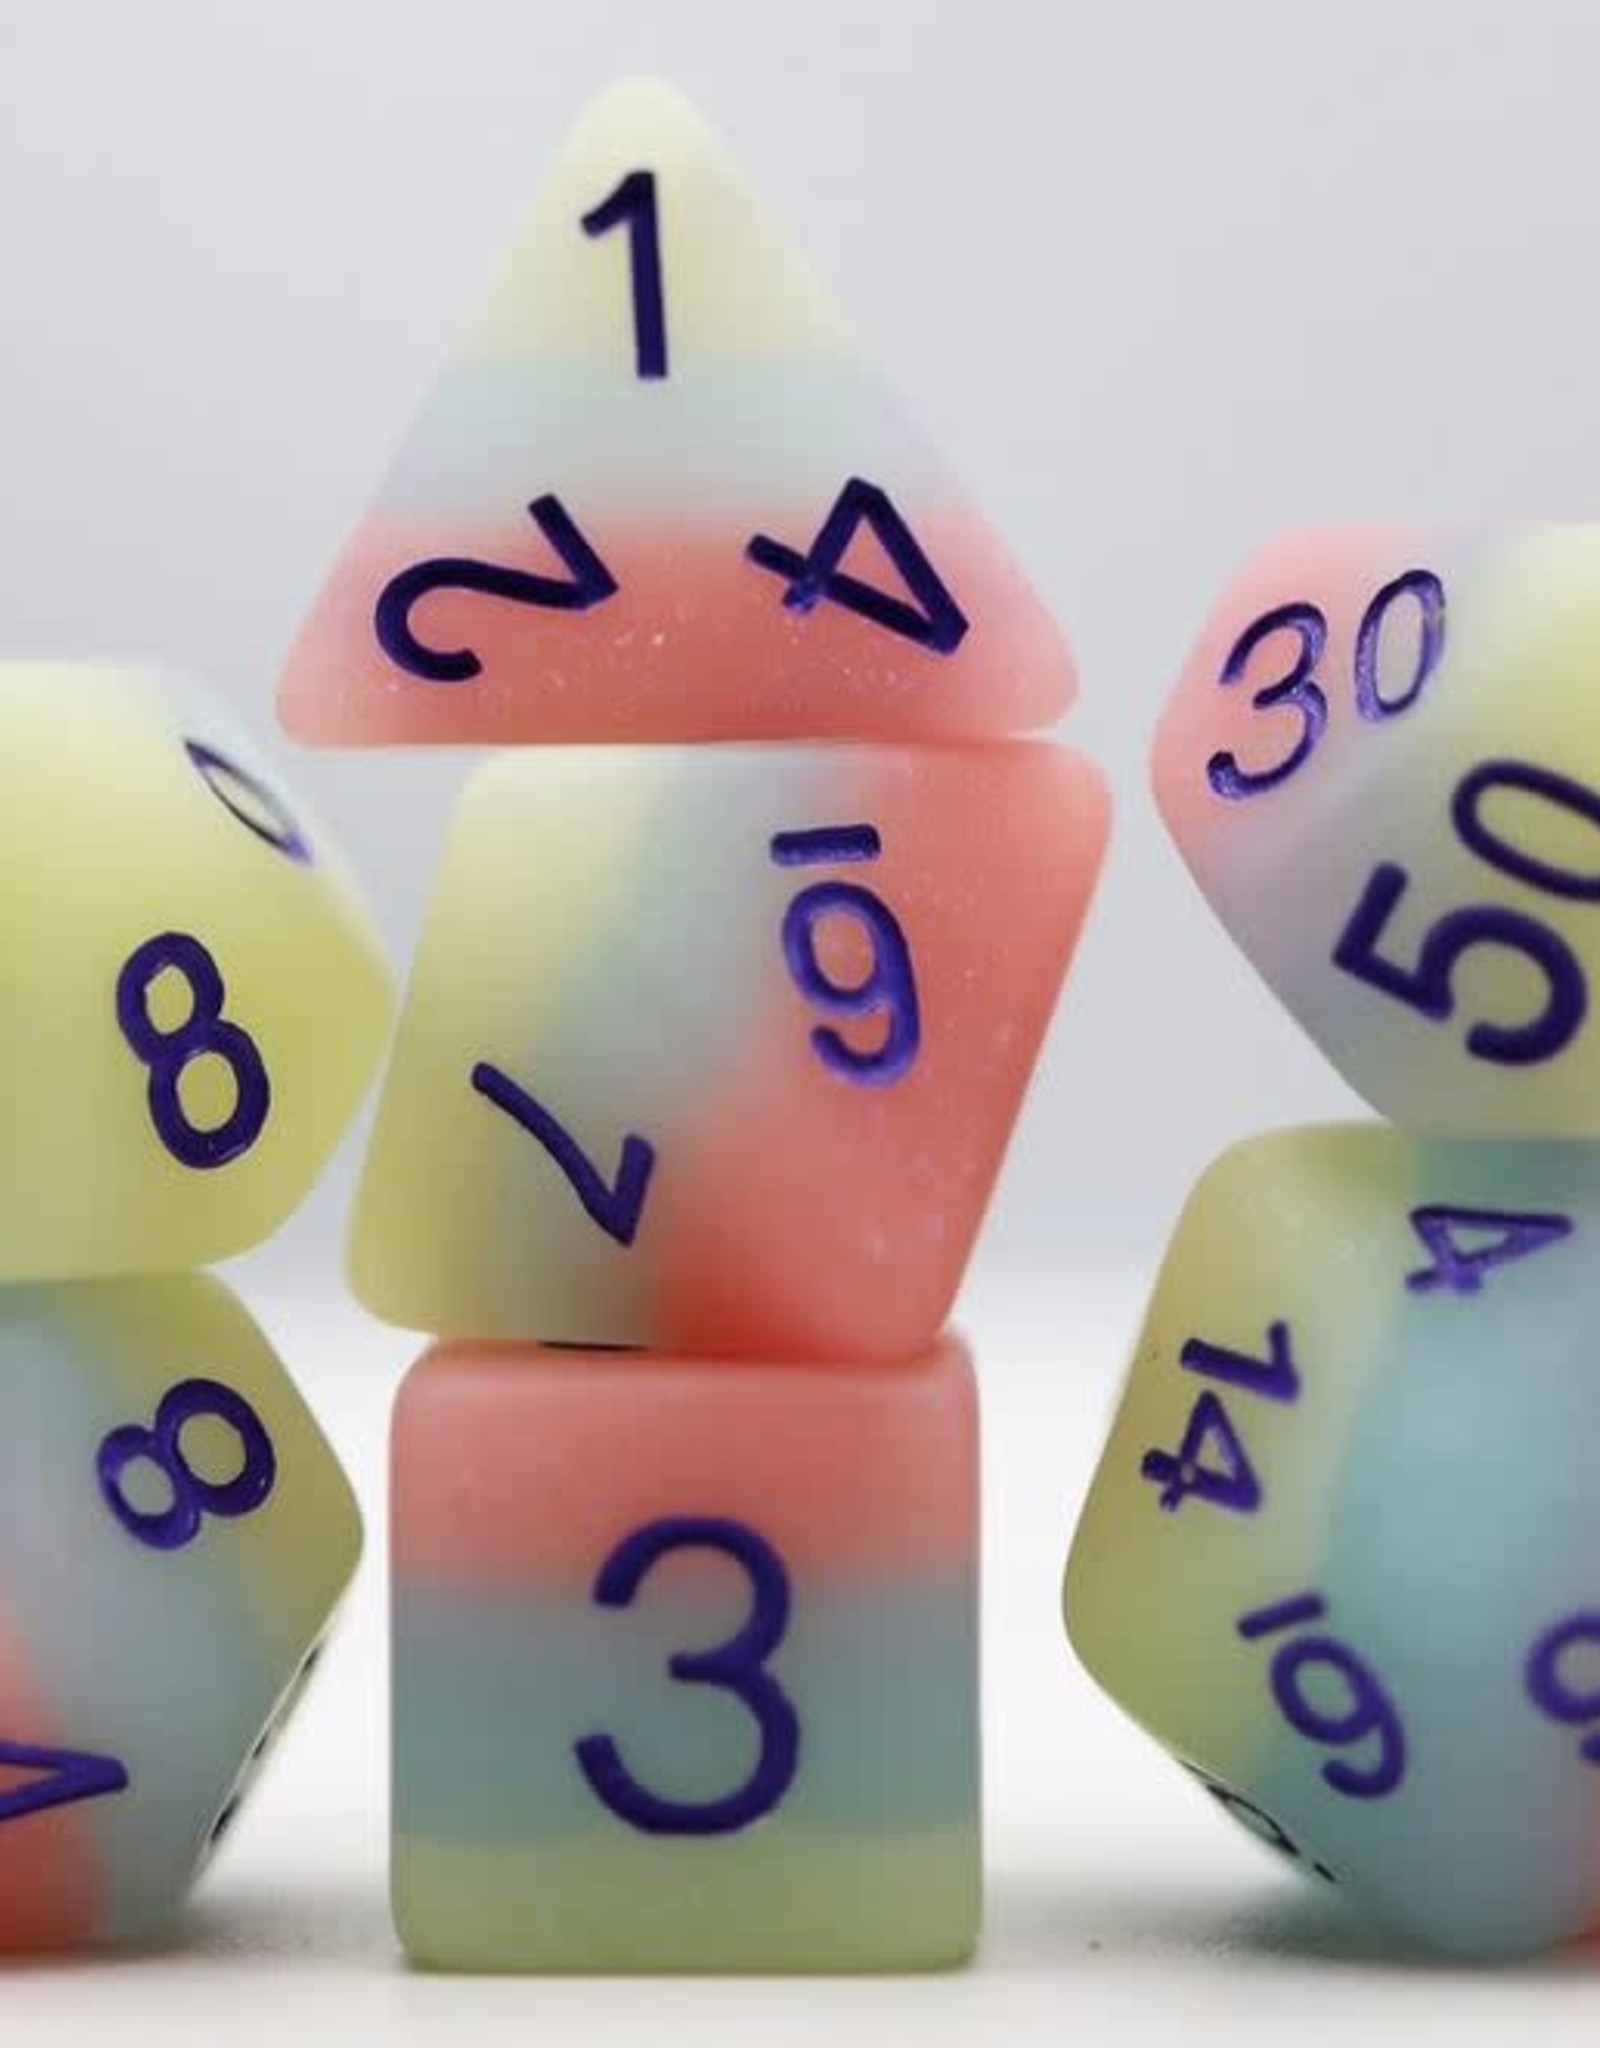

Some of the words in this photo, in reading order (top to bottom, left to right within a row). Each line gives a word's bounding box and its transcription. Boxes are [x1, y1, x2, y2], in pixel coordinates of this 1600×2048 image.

[580, 170, 669, 380] 1
[373, 493, 620, 688] 2
[742, 476, 971, 660] 4
[1205, 567, 1446, 801] 30
[1329, 757, 1600, 1068] 50
[115, 931, 271, 1170] 8
[1405, 1203, 1577, 1296] 4
[95, 1377, 278, 1553] 8
[1140, 1320, 1302, 1515] 14
[571, 1510, 805, 1838] 3
